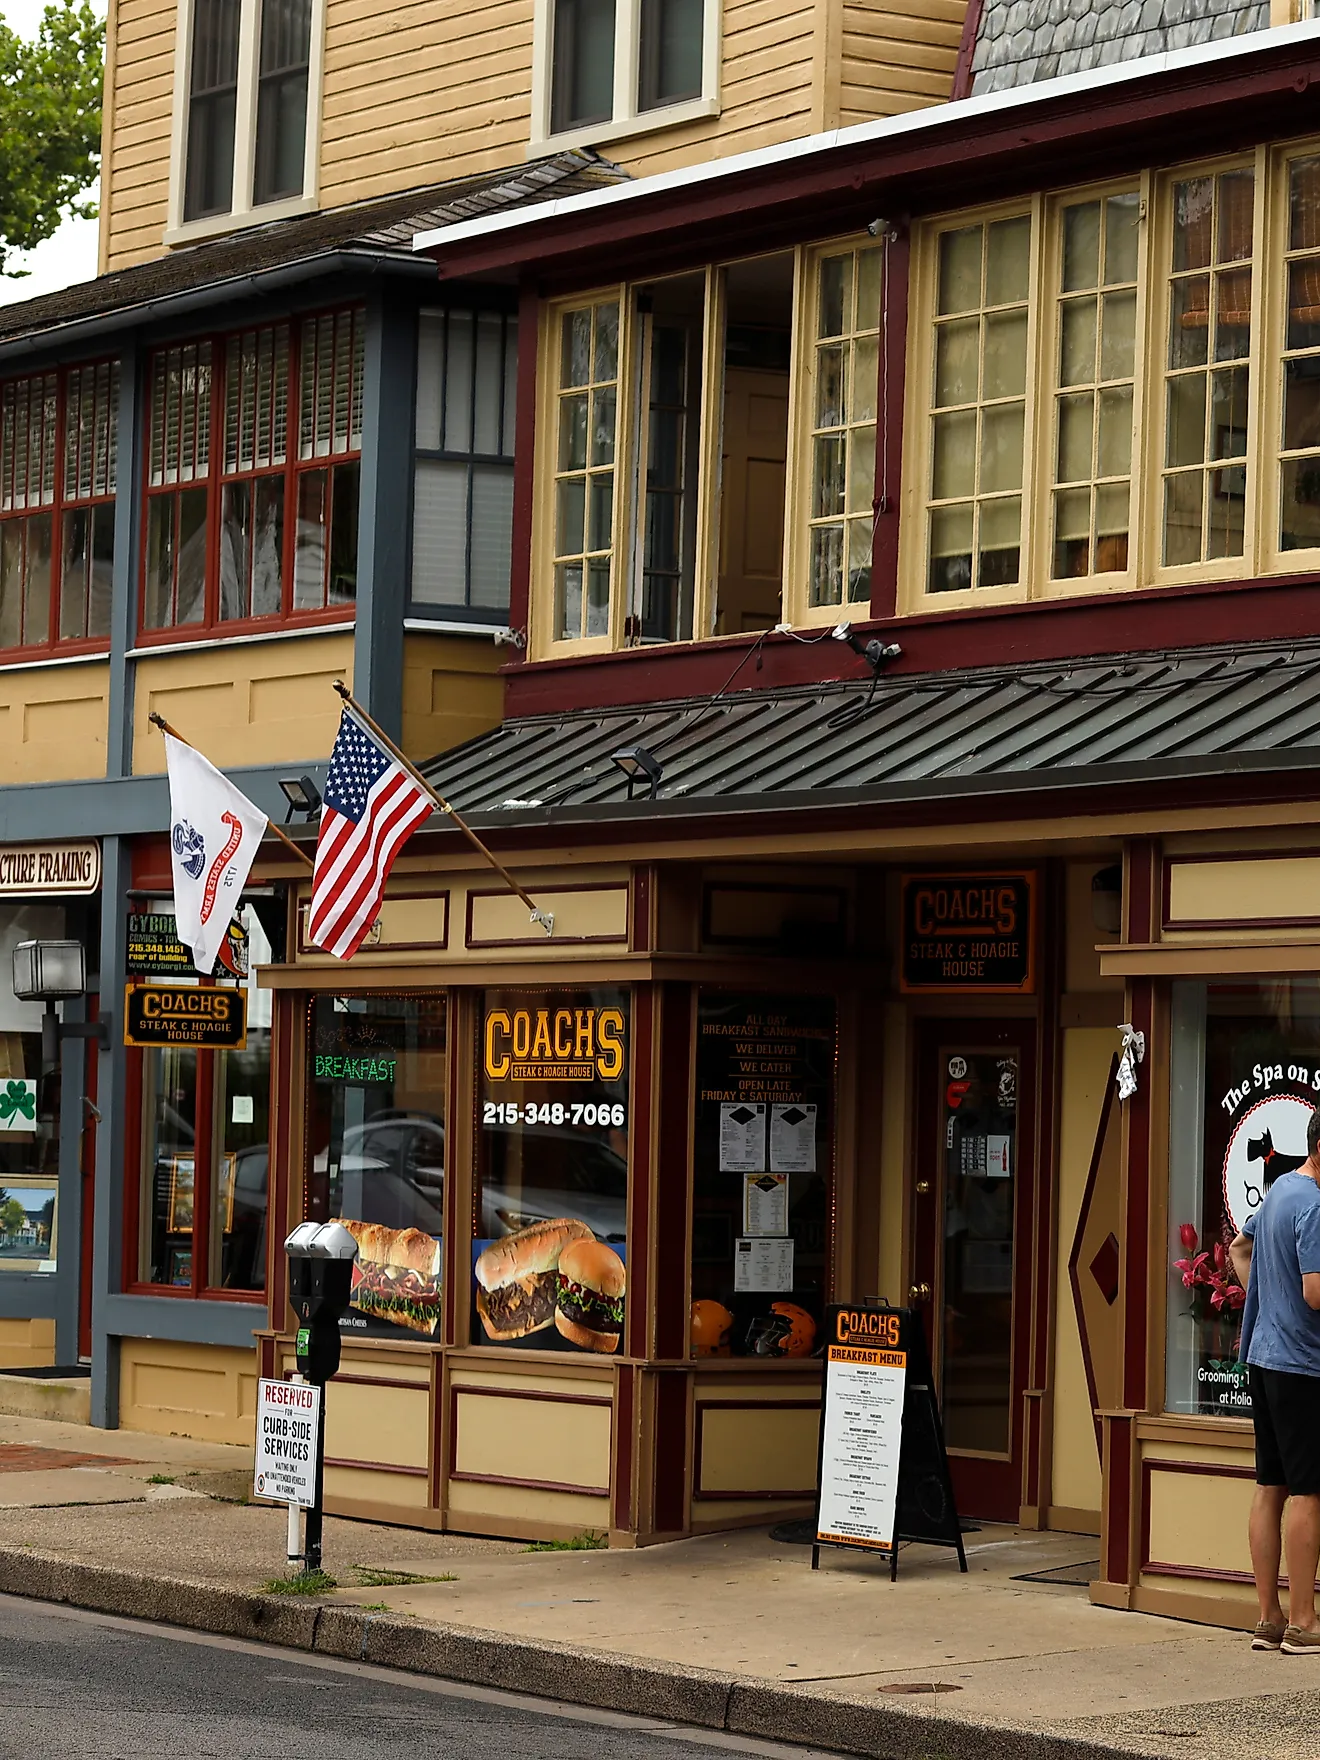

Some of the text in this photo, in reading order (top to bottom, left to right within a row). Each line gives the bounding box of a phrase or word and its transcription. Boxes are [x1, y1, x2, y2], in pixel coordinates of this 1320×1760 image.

[37, 850, 92, 883] FRAMING
[129, 914, 177, 934] CYBOR
[129, 933, 158, 944] COMICS
[909, 942, 954, 959] STEAK
[970, 942, 1020, 958] HOAGIE
[158, 953, 189, 963] building
[941, 961, 985, 977] HOUSE
[139, 1020, 177, 1031] STEAK
[191, 1022, 232, 1033] HOAGIE
[746, 1014, 788, 1026] ALL DAY
[167, 1030, 204, 1041] HOUSE
[702, 1024, 760, 1036] BREAKFAST
[735, 1043, 797, 1055] WE DELIVER
[314, 1054, 397, 1083] BREAKFAST
[513, 1066, 536, 1077] STEAK
[543, 1066, 568, 1077] HOAGIE
[569, 1066, 591, 1078] HOUSE
[740, 1061, 793, 1073] WE CATER
[738, 1080, 791, 1091] OPEN LATE
[1221, 1079, 1251, 1117] The
[1252, 1062, 1284, 1090] Spa
[1287, 1064, 1308, 1085] on
[701, 1090, 737, 1101] FRIDAY
[749, 1092, 802, 1102] SATURDAY
[483, 1102, 625, 1127] 215-348-7066
[831, 1348, 903, 1365] BREAKFAST MENU
[1197, 1367, 1240, 1389] Grooming
[265, 1384, 313, 1409] RESERVED
[1219, 1392, 1230, 1404] at
[284, 1408, 293, 1417] FOR
[263, 1416, 312, 1441] CURB-SIDE
[264, 1437, 309, 1462] SERVICES
